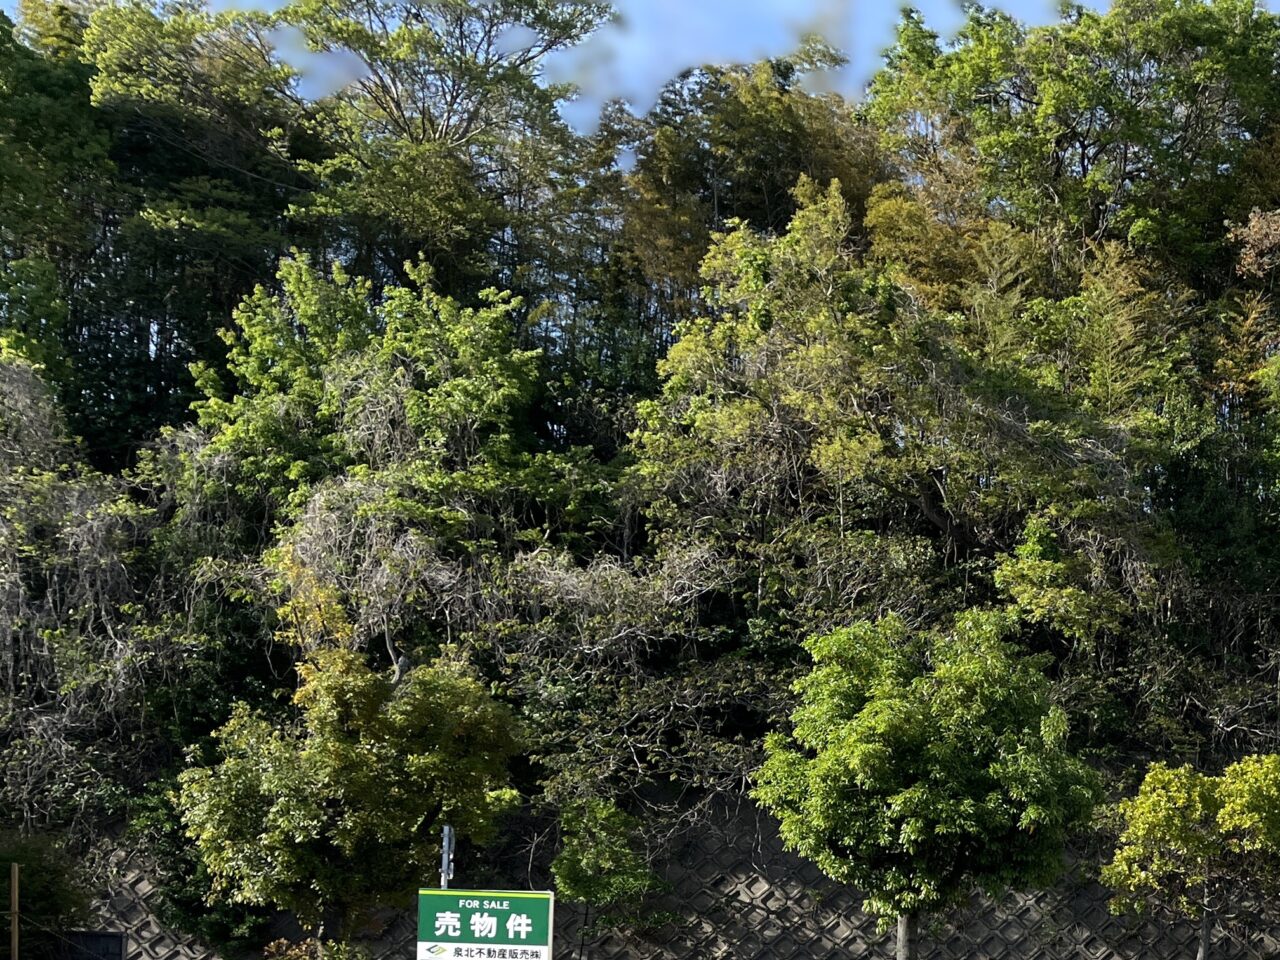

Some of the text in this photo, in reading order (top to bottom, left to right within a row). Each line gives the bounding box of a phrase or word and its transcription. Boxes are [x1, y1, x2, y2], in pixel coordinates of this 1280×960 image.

[458, 899, 510, 910] FOR SALE
[434, 911, 533, 939] 売物件
